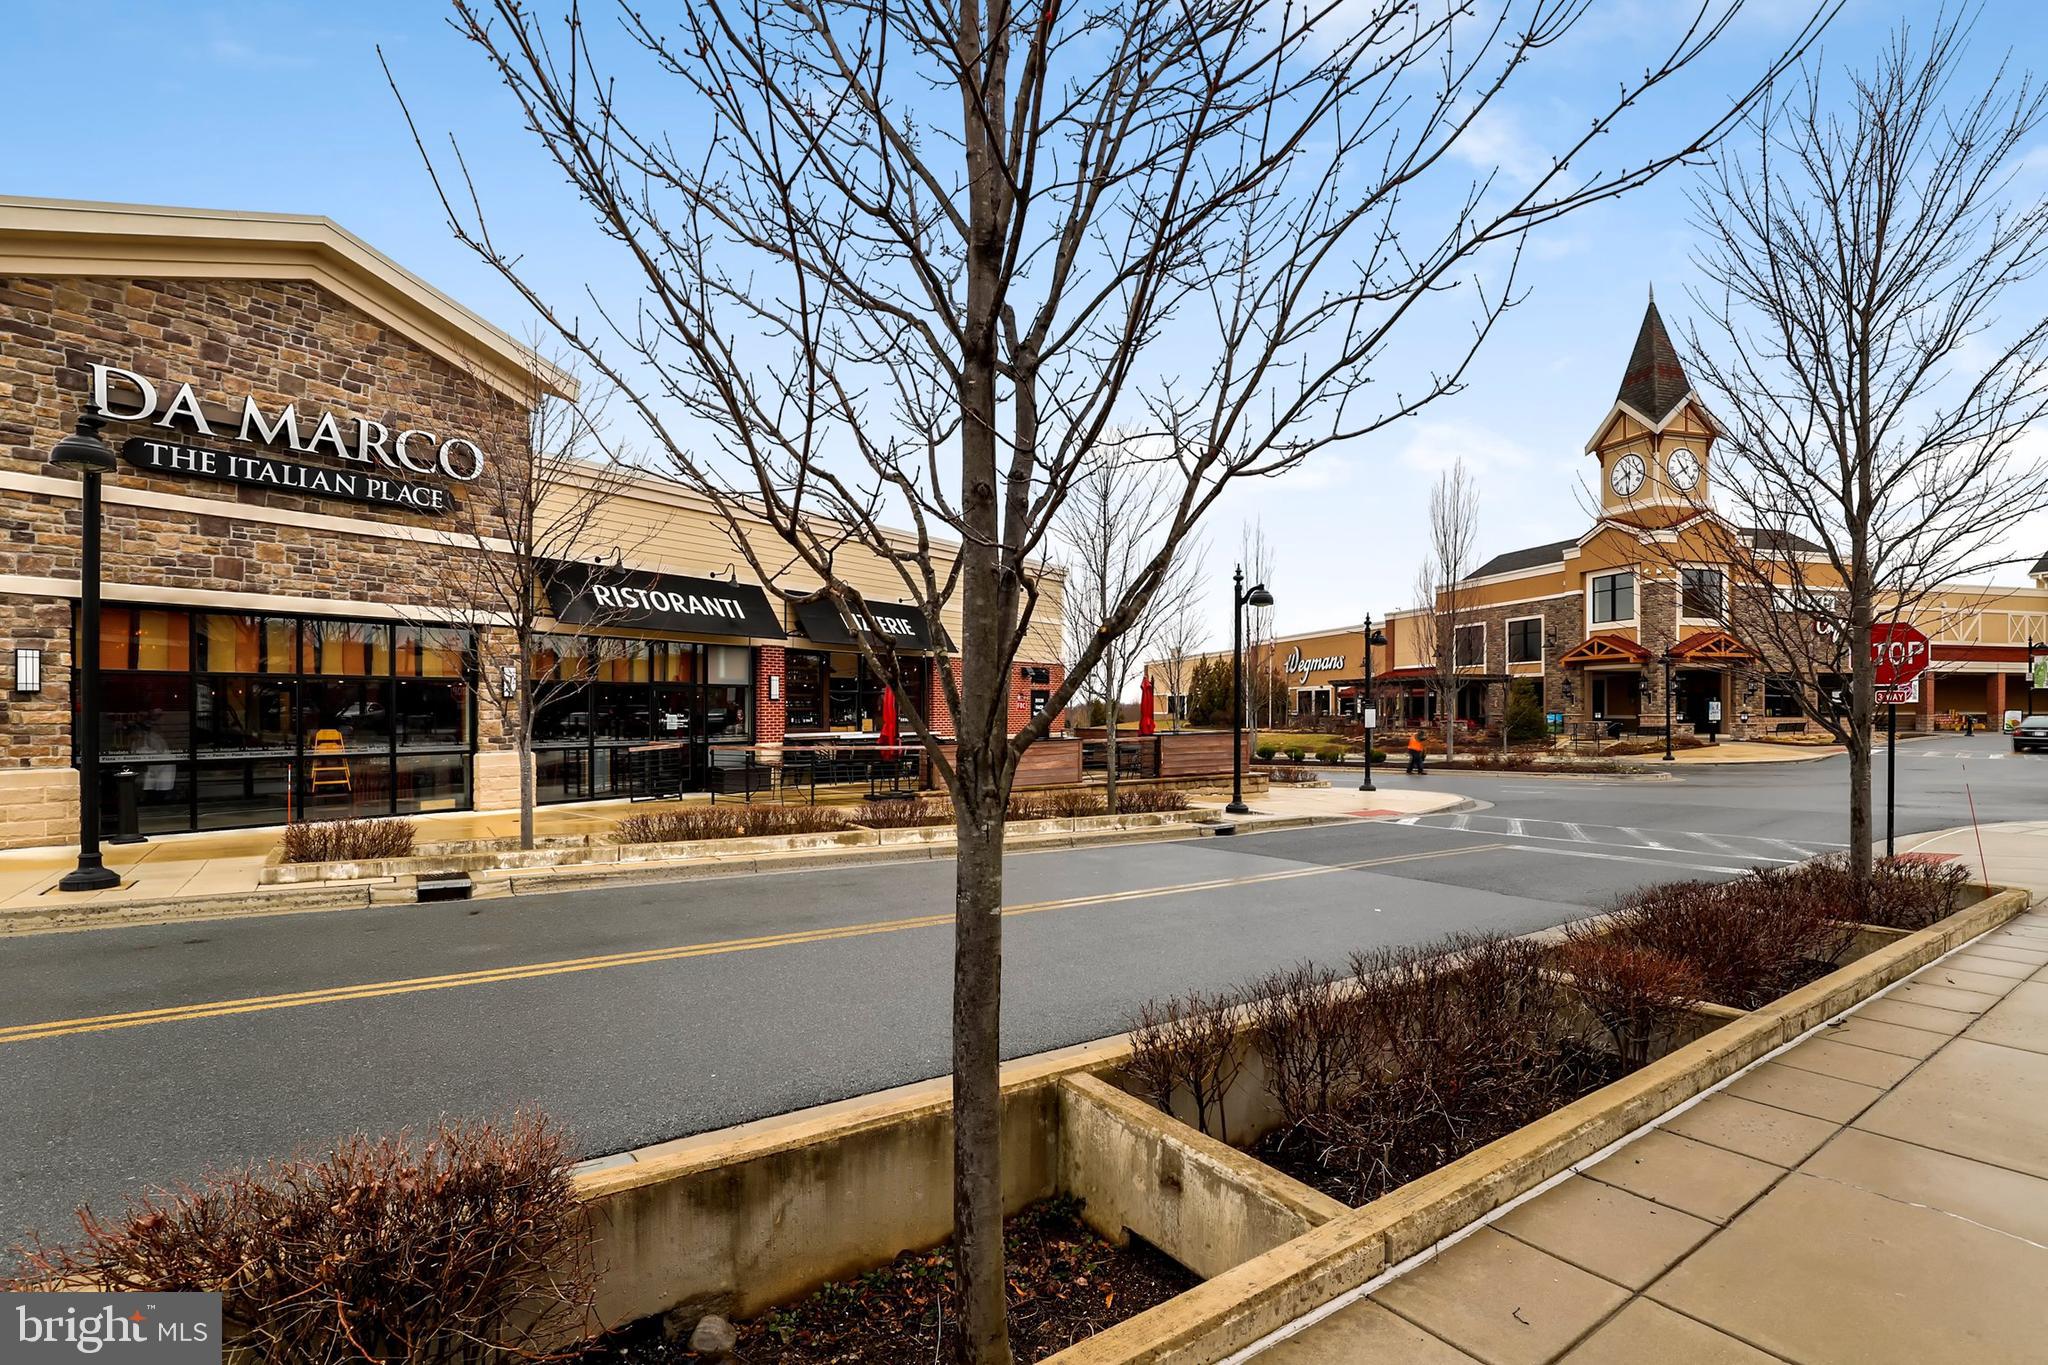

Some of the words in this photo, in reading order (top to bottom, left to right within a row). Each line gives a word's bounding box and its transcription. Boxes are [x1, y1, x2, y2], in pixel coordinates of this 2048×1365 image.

[86, 362, 218, 437] DA
[234, 394, 485, 481] MARCO
[143, 441, 216, 474] THE
[228, 455, 357, 496] ITALIAN
[366, 478, 443, 508] PLACE
[592, 584, 746, 619] RISTORANTI
[839, 612, 916, 636] IZERIE
[1284, 646, 1345, 684] Wegmans
[1869, 641, 1925, 666] TOP
